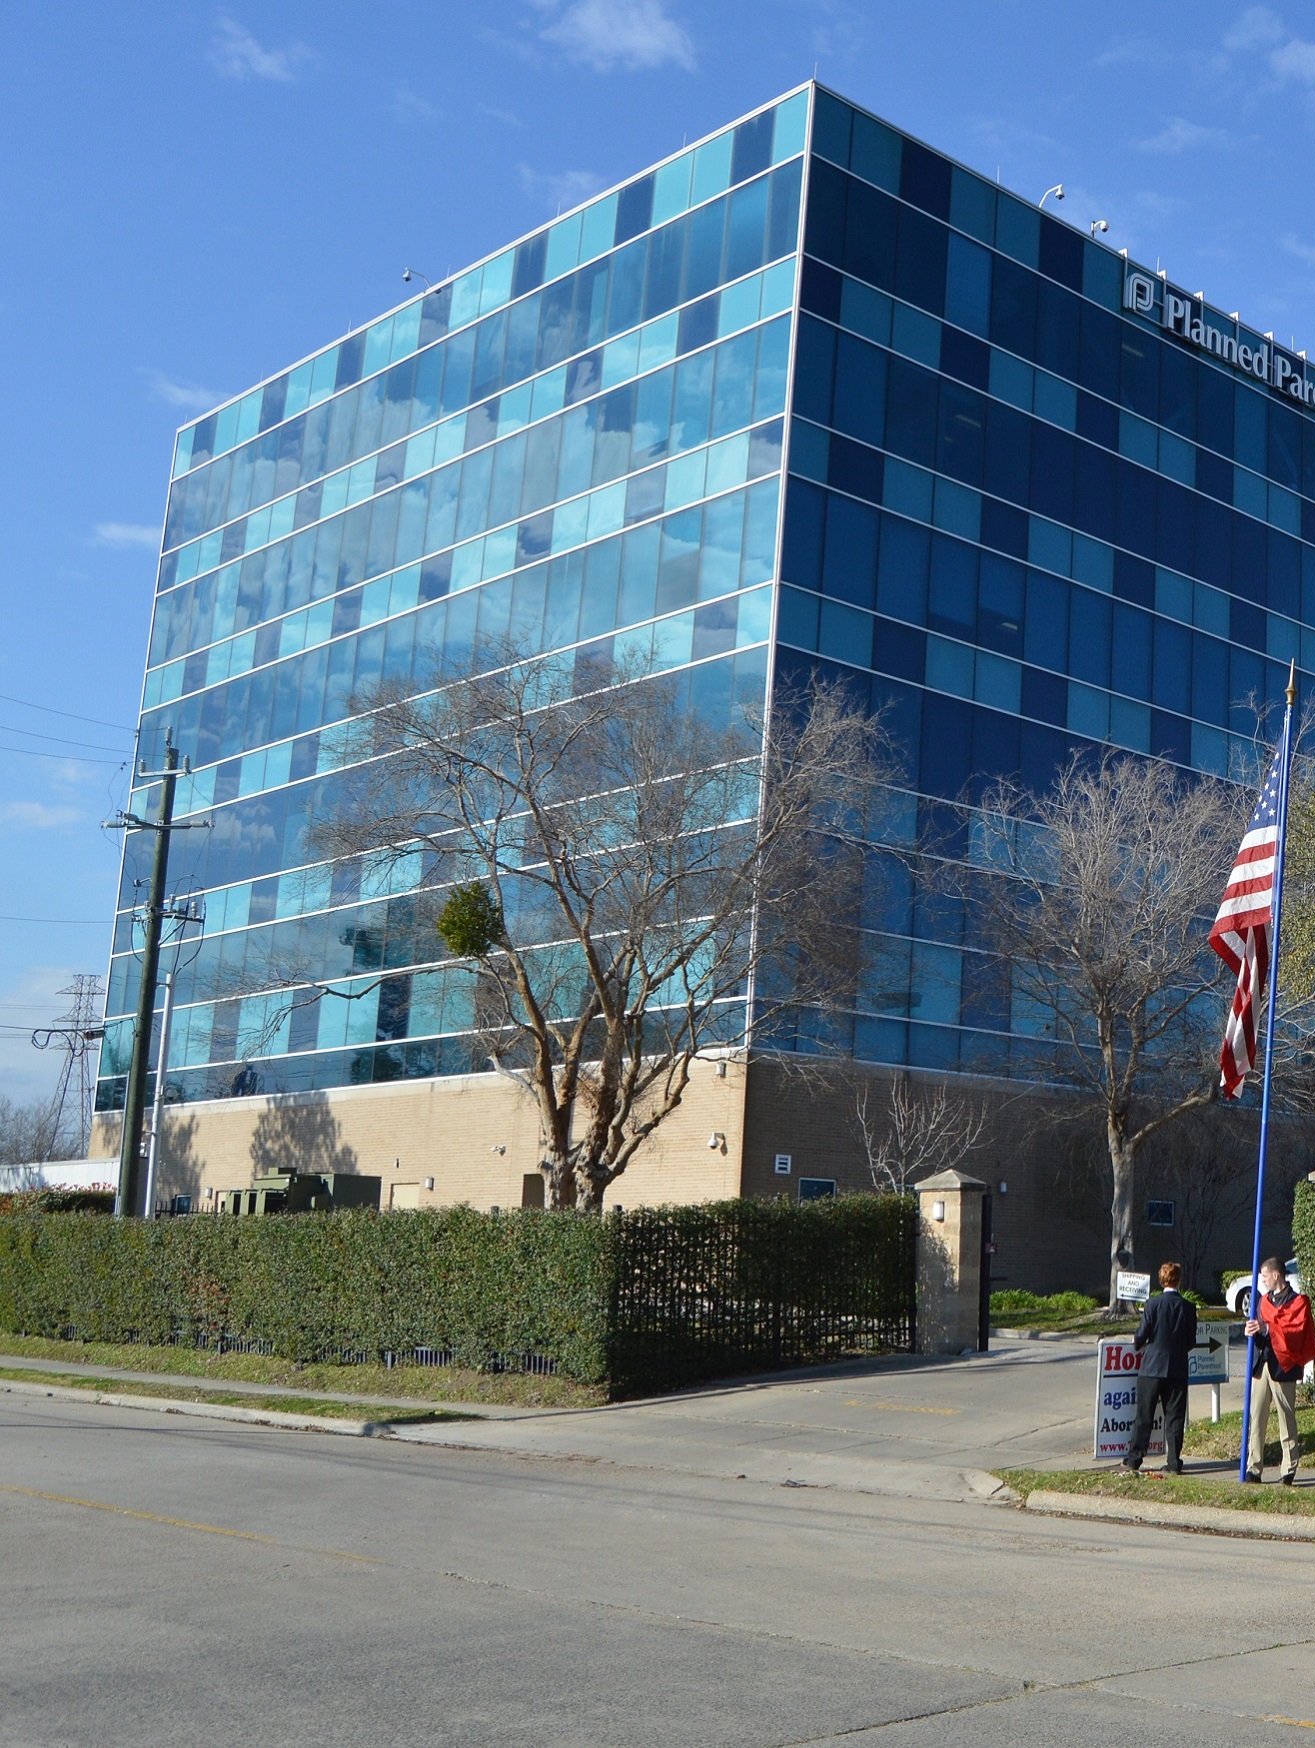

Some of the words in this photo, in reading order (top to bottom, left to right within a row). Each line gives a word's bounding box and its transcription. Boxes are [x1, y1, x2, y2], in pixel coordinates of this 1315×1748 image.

[1167, 294, 1268, 380] Planned
[1121, 1273, 1146, 1281] SHIPPING
[1119, 1285, 1147, 1295] RECEIVING
[1197, 1355, 1216, 1363] Planned
[1197, 1362, 1222, 1370] Parenthood
[1101, 1416, 1162, 1433] Aborn!
